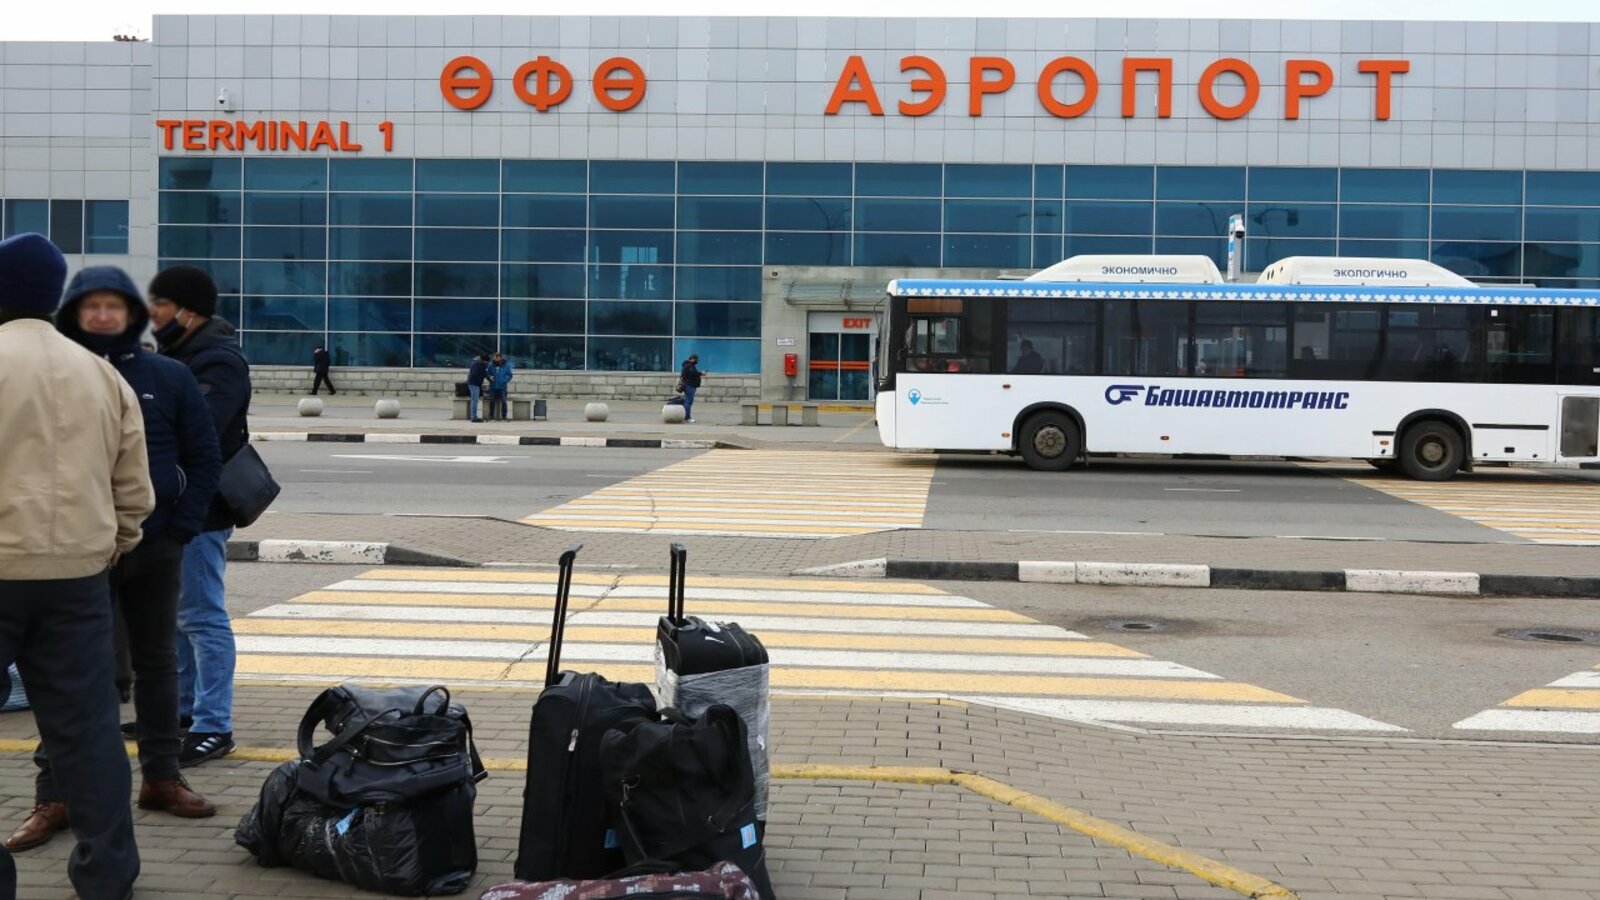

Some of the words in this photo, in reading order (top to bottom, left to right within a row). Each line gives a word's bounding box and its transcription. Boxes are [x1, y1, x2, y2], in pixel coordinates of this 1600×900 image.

[825, 55, 1410, 120] АЭРОПОРТ
[157, 120, 361, 151] TERMINAL
[379, 120, 394, 152] 1
[1101, 266, 1178, 275] ЭКОНОМИЧНО
[1333, 269, 1407, 278] ЭКОЛОГИЧНО
[842, 317, 872, 329] EXIT
